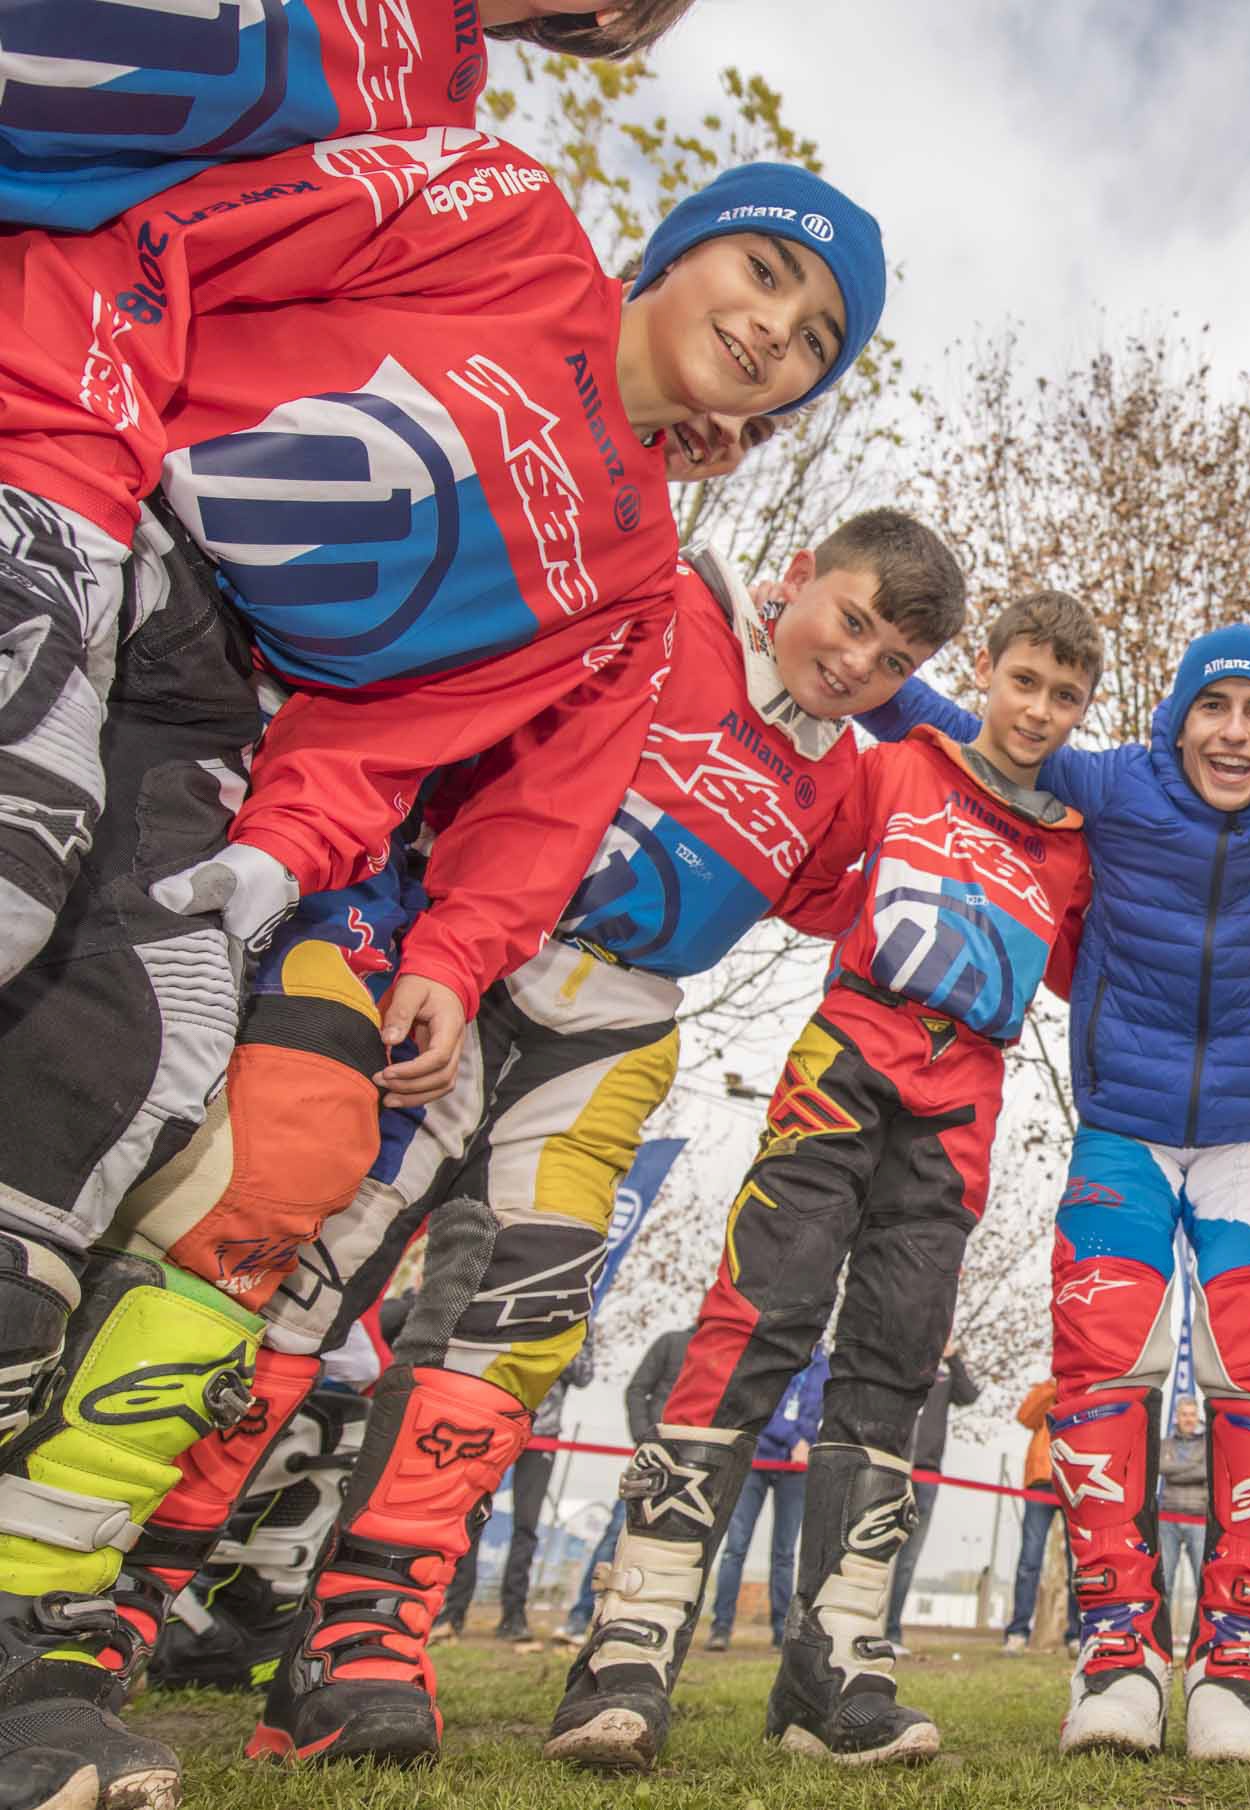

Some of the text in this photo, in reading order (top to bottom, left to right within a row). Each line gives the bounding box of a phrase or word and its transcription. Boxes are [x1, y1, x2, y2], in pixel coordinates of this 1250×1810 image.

[421, 177, 494, 221] laps
[717, 205, 798, 223] Allianz
[564, 349, 626, 486] Allianz
[718, 709, 795, 785] Allianz
[946, 789, 1022, 844] Allianz
